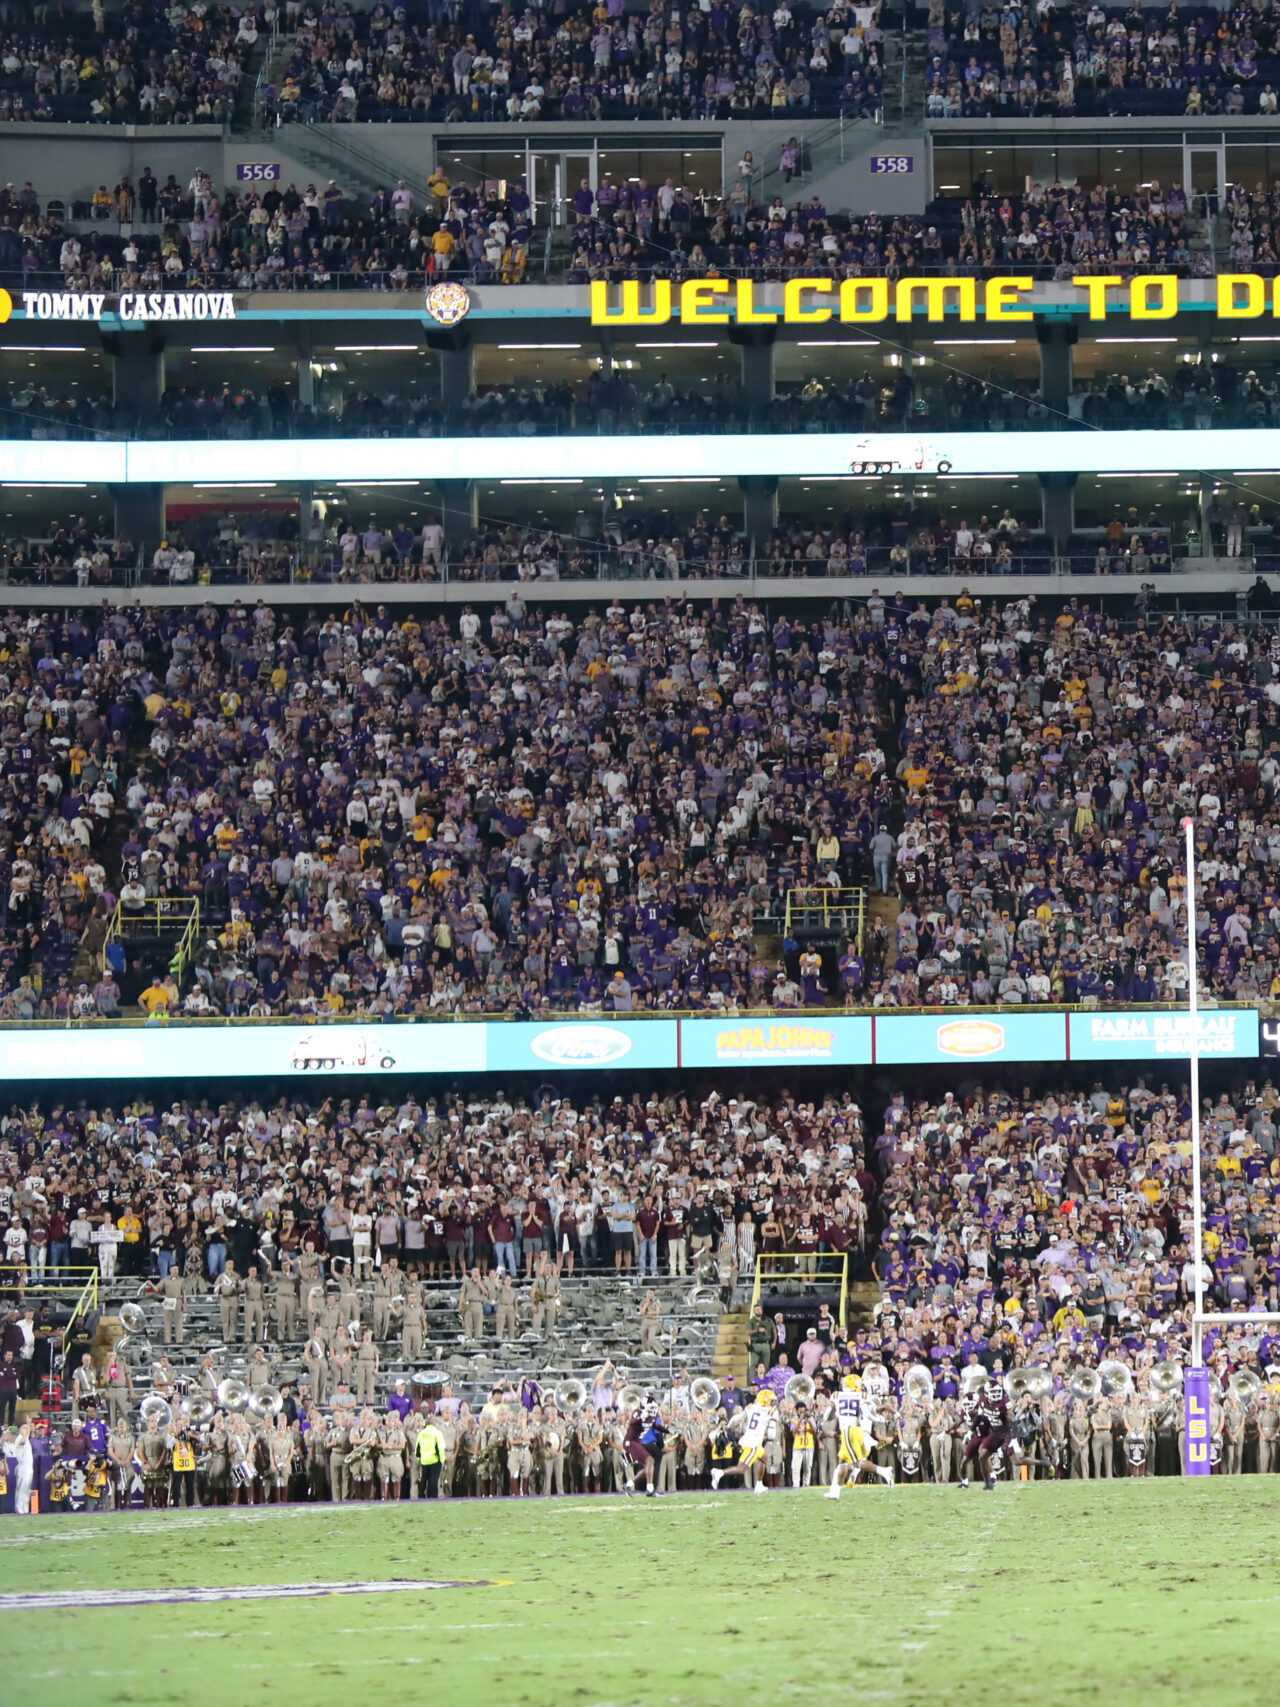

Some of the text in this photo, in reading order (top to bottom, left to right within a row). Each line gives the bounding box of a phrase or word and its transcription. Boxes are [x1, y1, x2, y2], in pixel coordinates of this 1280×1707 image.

[243, 165, 275, 180] 556
[876, 156, 908, 173] 558
[23, 292, 236, 320] TOMMY CASANOVA
[591, 276, 1034, 326] WELCOME
[1072, 275, 1178, 320] TO
[1092, 1018, 1149, 1036] FARM
[551, 1038, 611, 1057] Ford
[839, 1399, 860, 1416] 29
[749, 1413, 761, 1430] 6
[1189, 1396, 1207, 1462] LSU
[90, 1428, 99, 1441] 2
[179, 1459, 190, 1468] 30
